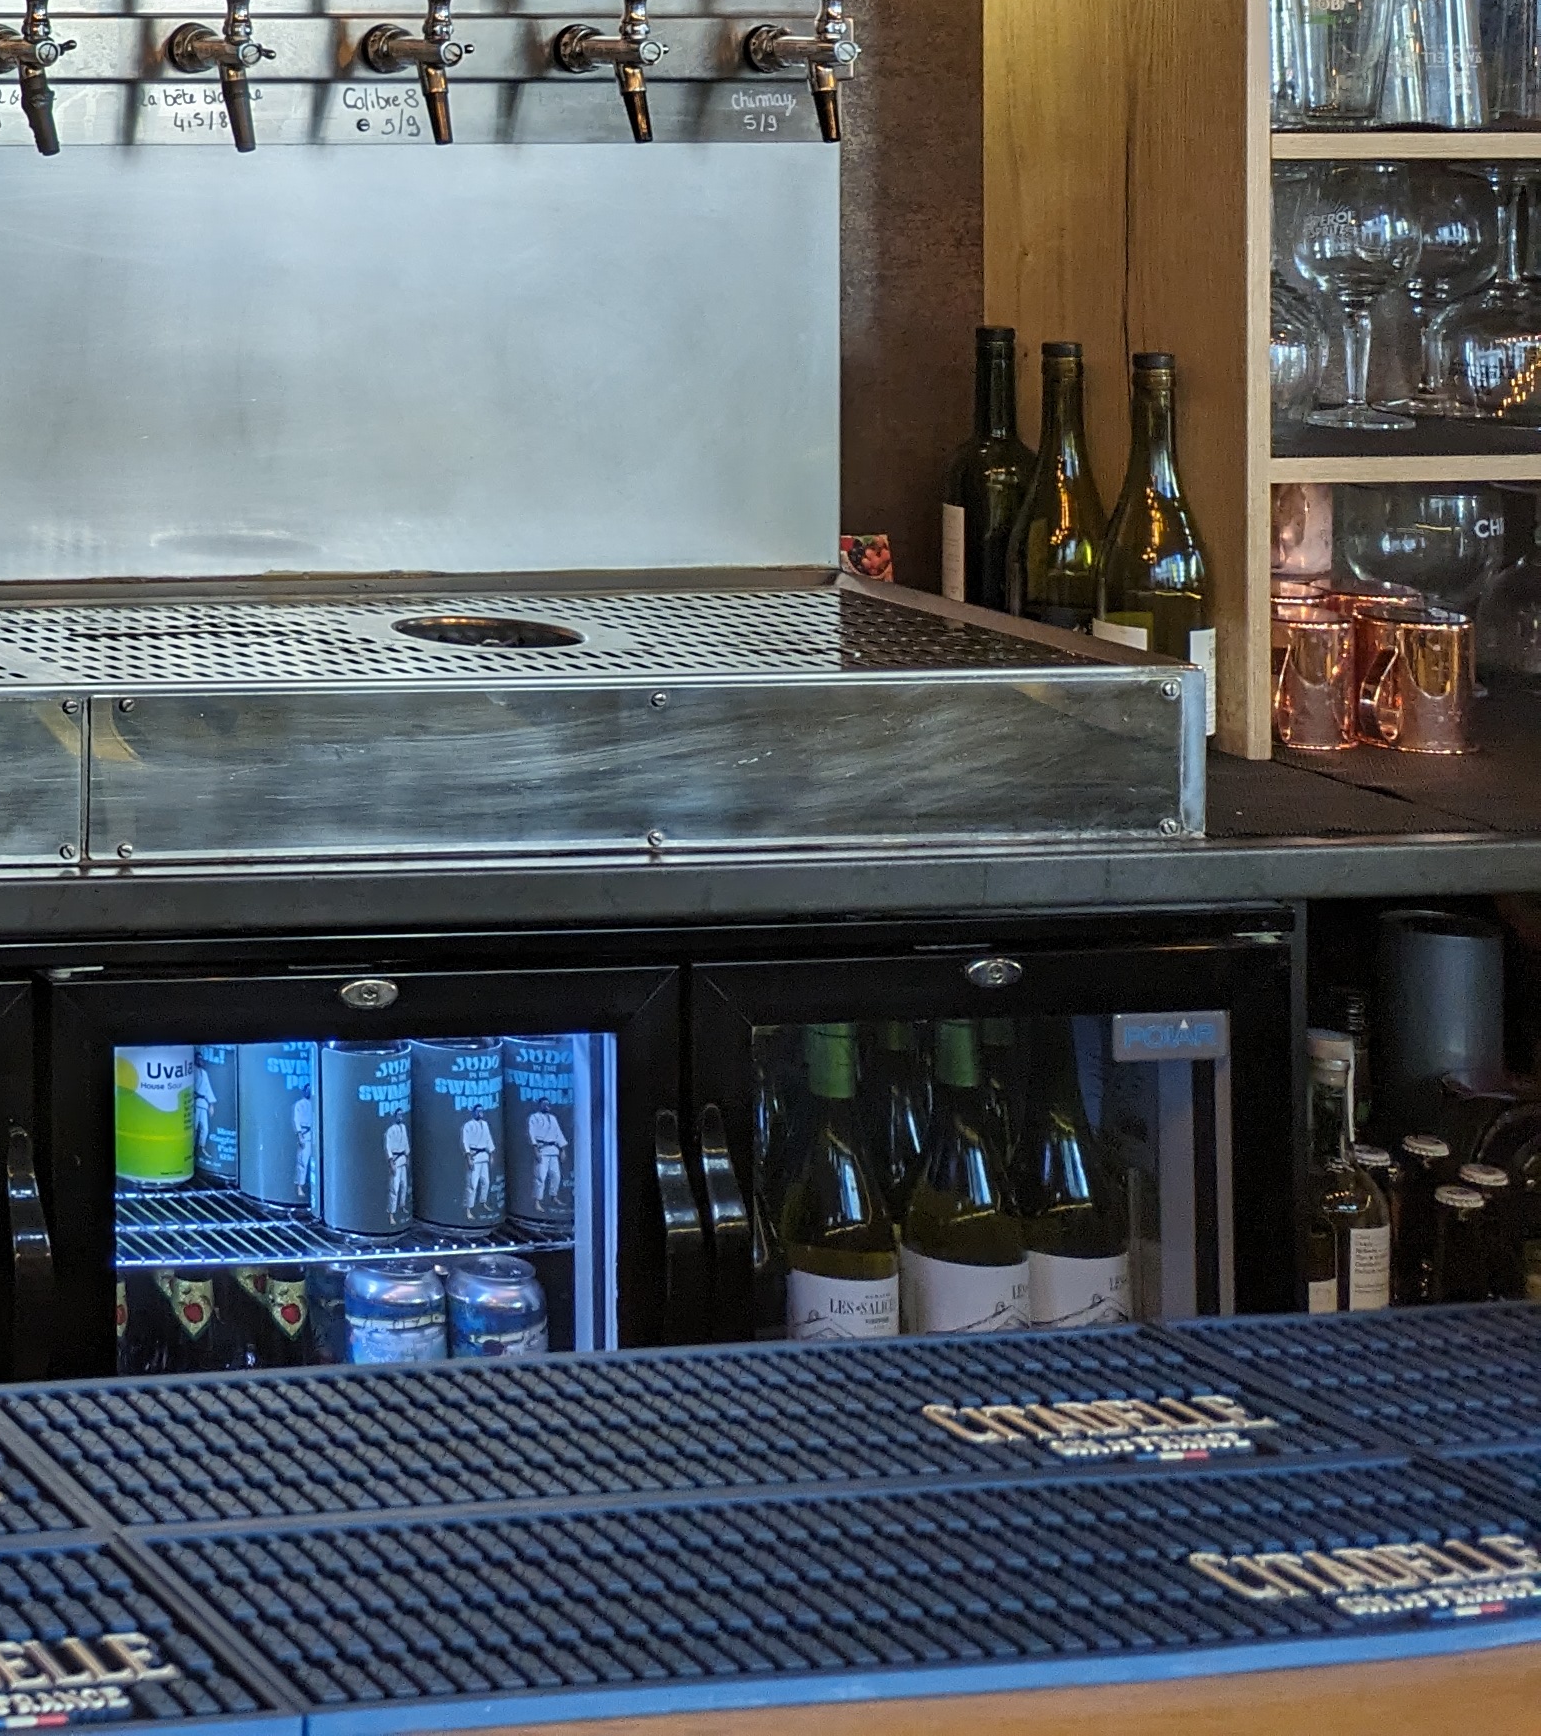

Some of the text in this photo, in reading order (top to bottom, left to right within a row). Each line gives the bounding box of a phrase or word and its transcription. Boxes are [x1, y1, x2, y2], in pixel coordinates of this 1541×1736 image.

[162, 86, 200, 107] bête
[343, 87, 419, 110] Calibre 8
[731, 90, 796, 113] chimay
[381, 116, 421, 136] 5/9
[743, 114, 777, 132] 5/9
[1124, 1021, 1218, 1048] POLAR
[452, 1055, 499, 1072] JUDO
[516, 1049, 573, 1064] JUDO
[140, 1082, 165, 1090] House
[922, 1394, 1279, 1444] CITADELLE
